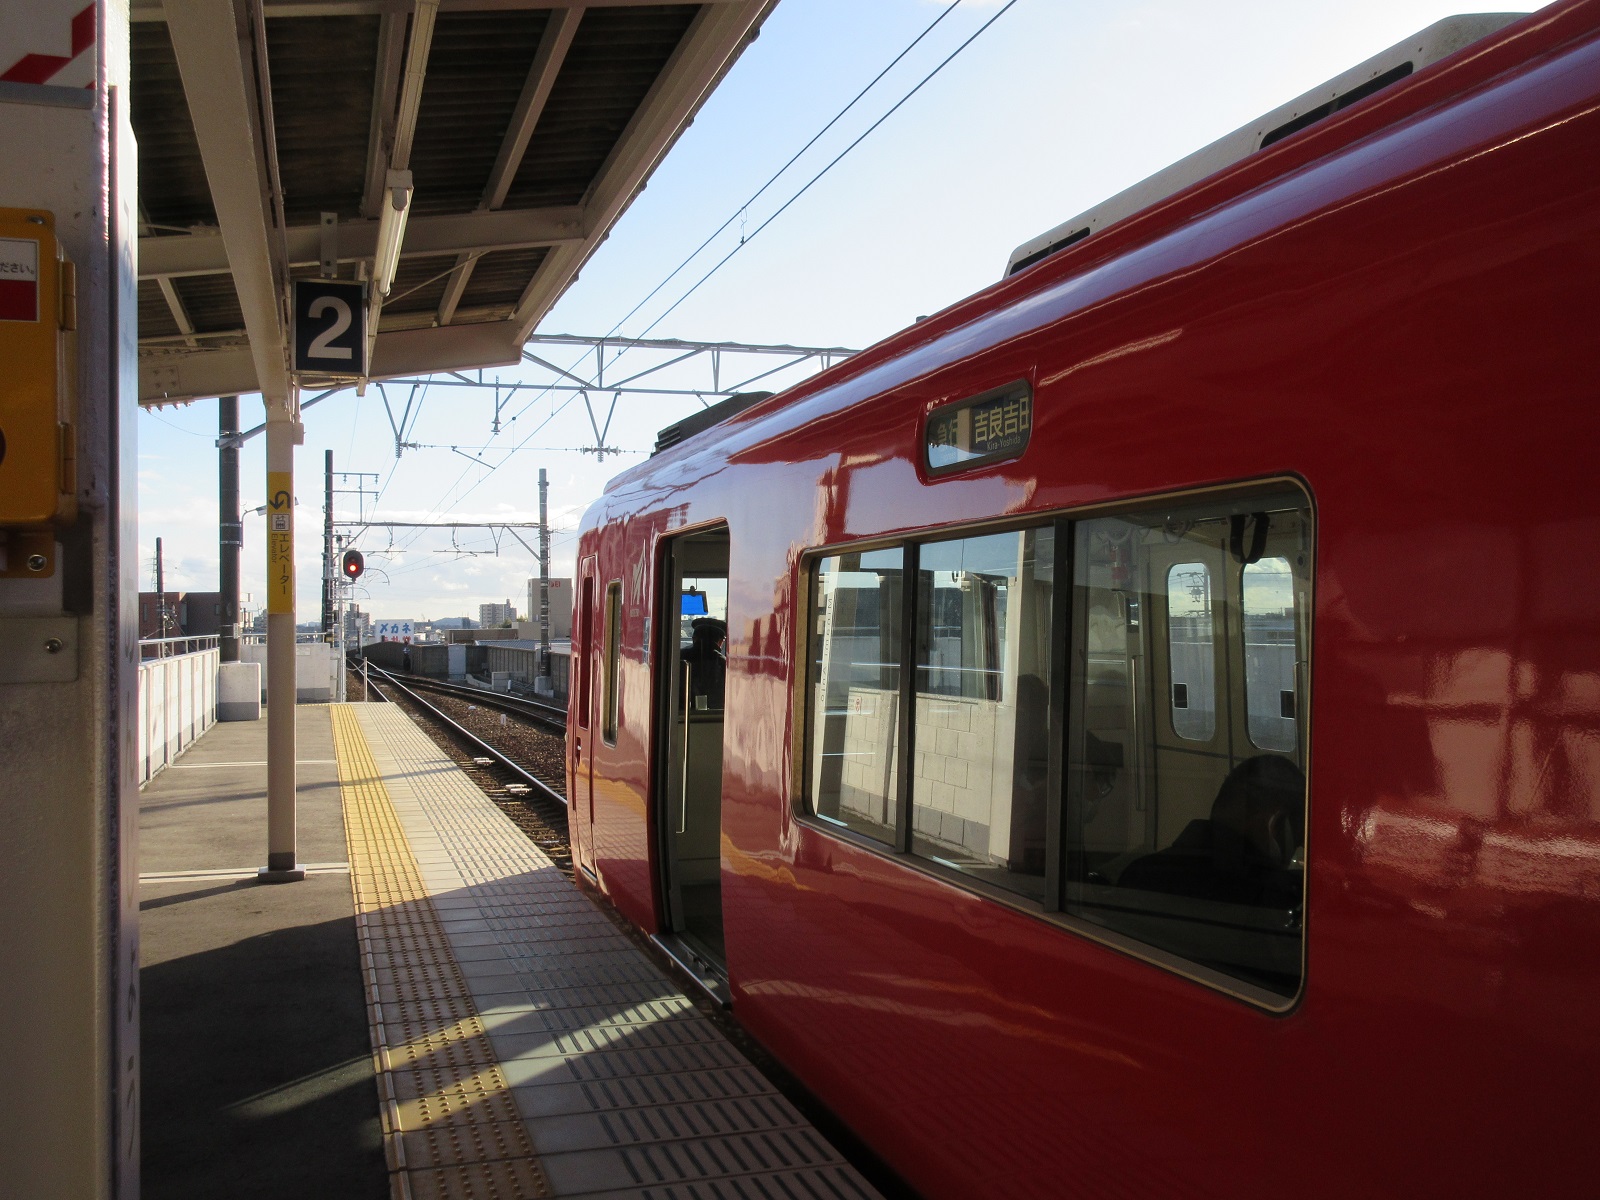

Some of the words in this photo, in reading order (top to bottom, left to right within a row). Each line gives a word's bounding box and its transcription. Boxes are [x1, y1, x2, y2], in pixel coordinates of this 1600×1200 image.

[307, 295, 352, 360] 2
[279, 533, 290, 595] エレベーター
